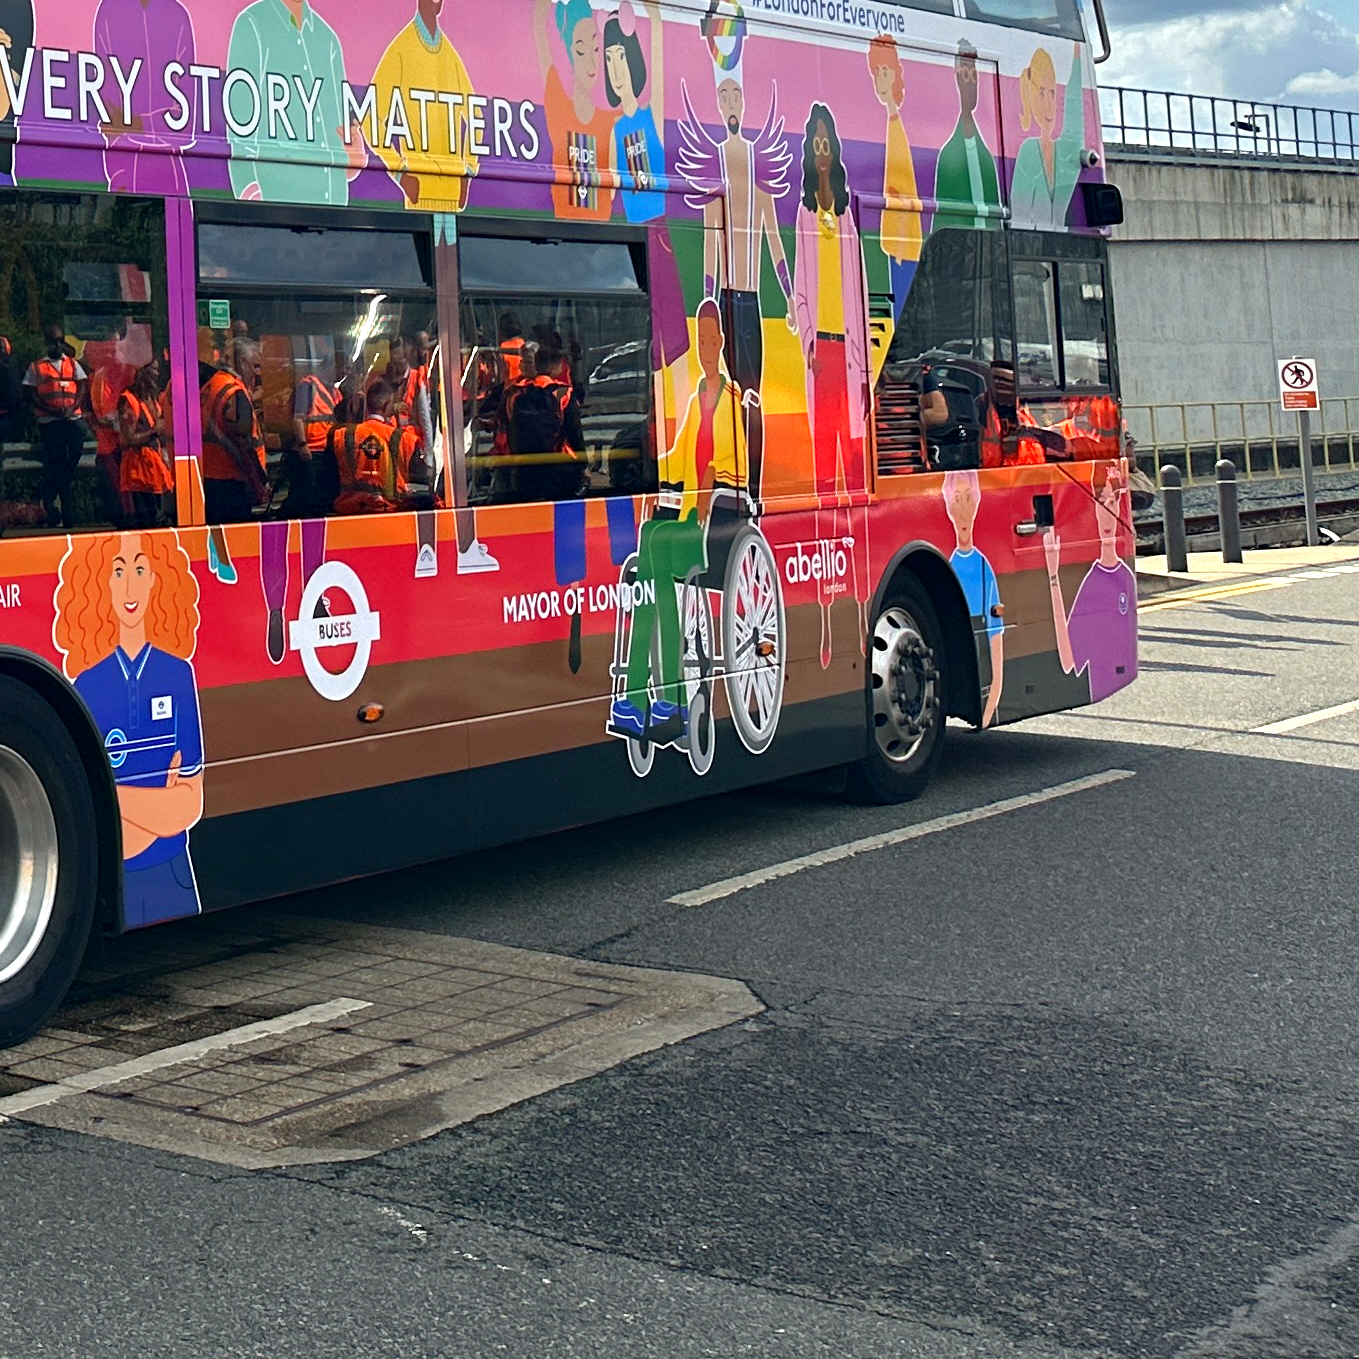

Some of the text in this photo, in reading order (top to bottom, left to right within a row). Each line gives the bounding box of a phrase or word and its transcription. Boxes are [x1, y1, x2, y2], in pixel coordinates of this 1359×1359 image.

[162, 59, 324, 142] STORY
[341, 82, 540, 161] MATTERS
[568, 145, 596, 165] PRIDE
[626, 138, 647, 160] PRIDE
[785, 538, 847, 584] abellio
[502, 578, 657, 624] MAYOR OF LONDON
[318, 620, 352, 640] BUSES
